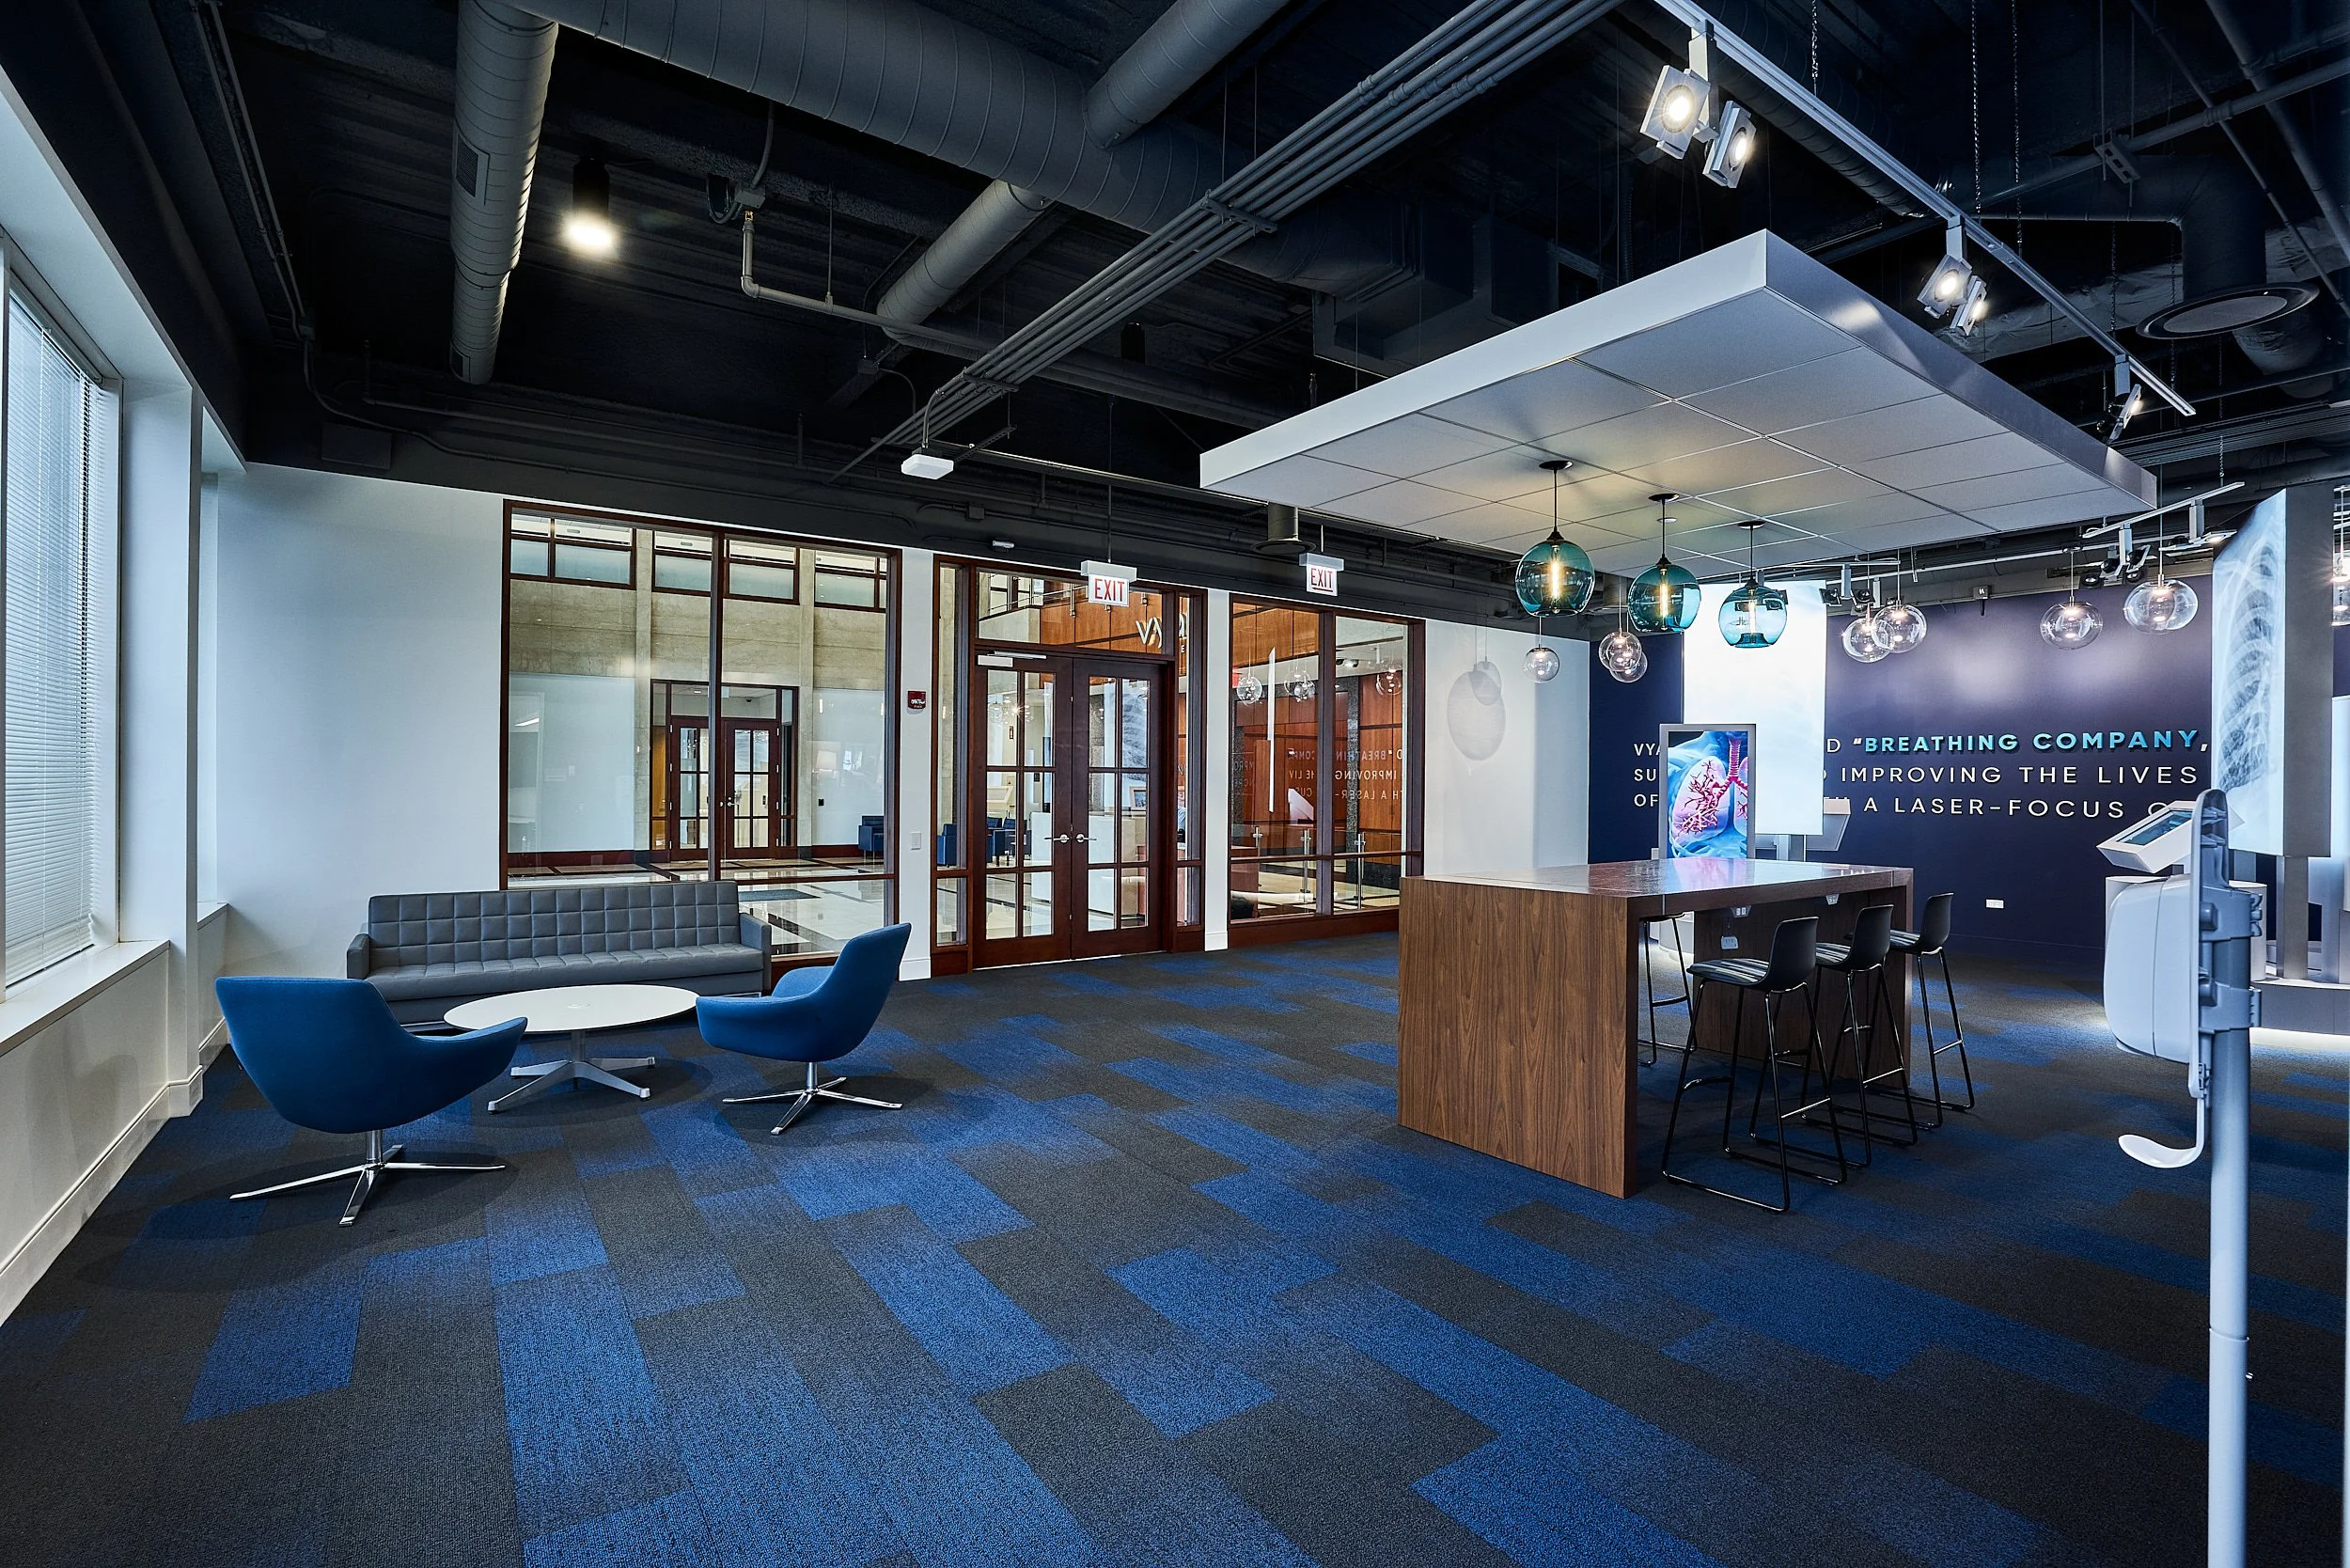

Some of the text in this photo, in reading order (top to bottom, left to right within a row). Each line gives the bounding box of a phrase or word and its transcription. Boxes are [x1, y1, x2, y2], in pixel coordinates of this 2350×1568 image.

[1310, 567, 1333, 588] EXIT
[1094, 577, 1125, 603] EXIT
[2032, 729, 2208, 753] COMPANY,
[1841, 766, 2002, 784] IMPROVING
[2018, 766, 2077, 784] THE
[2097, 765, 2198, 785] LIVES
[1863, 796, 1878, 812] A
[1894, 796, 2124, 819] LASER-FOCUS
